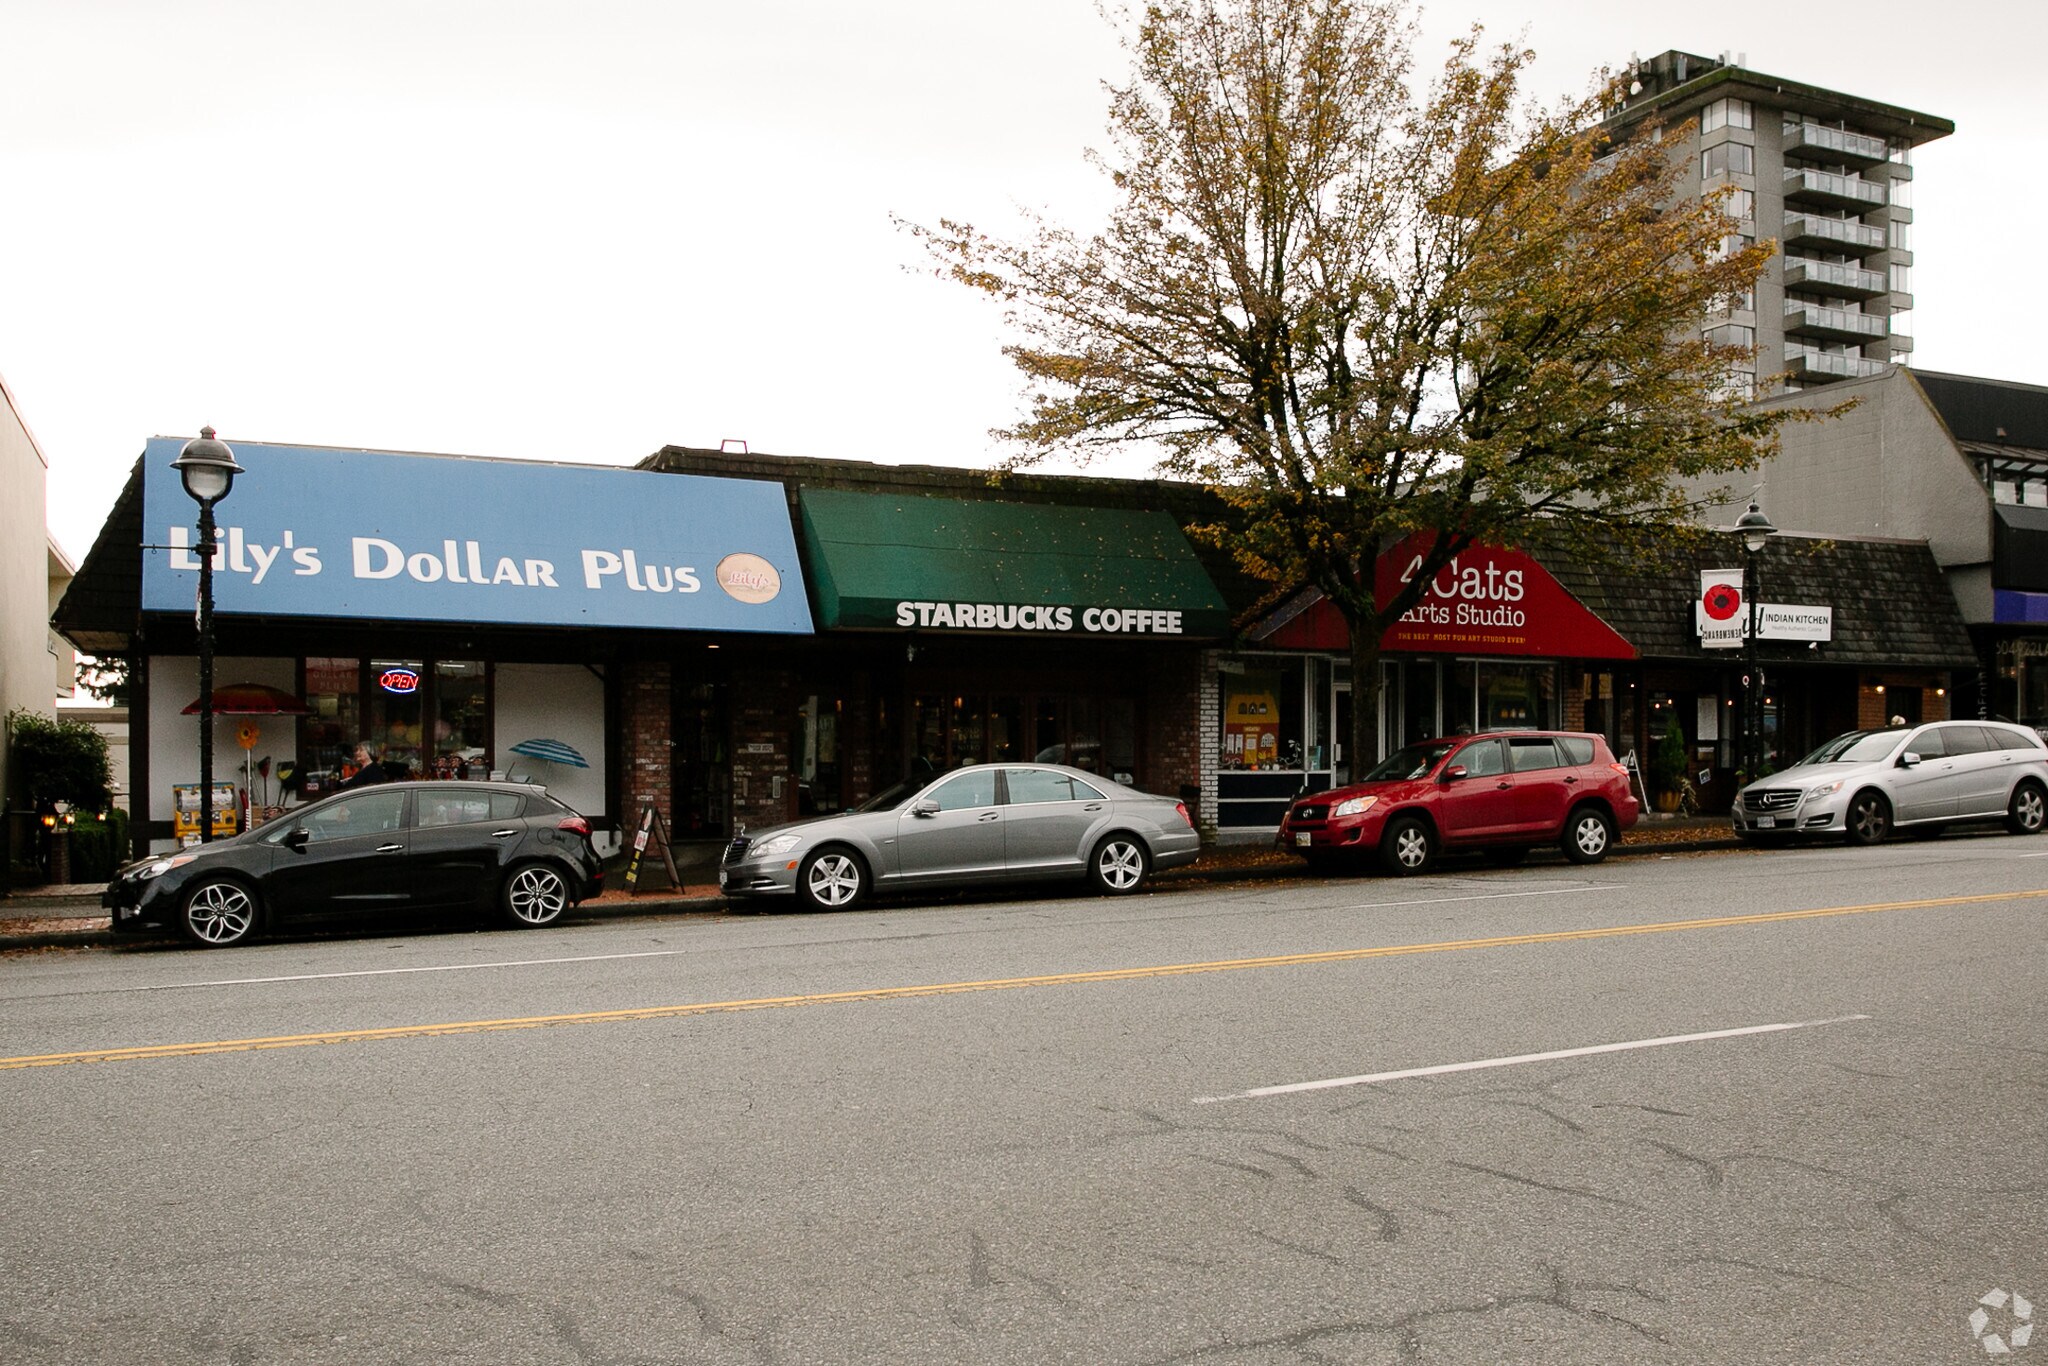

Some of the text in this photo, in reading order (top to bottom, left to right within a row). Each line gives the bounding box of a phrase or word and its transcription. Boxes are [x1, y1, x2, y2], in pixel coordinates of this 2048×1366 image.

[170, 527, 323, 585] Lily's
[896, 601, 1183, 634] STARBUCKS COFFEE
[1399, 602, 1526, 627] Arts Studio
[1765, 613, 1829, 625] INDIAN KITCHEN
[1398, 632, 1411, 640] THE
[1433, 633, 1451, 641] MOST
[1468, 634, 1481, 642] ART
[1482, 635, 1506, 643] STUDIO
[380, 673, 420, 689] OPEN
